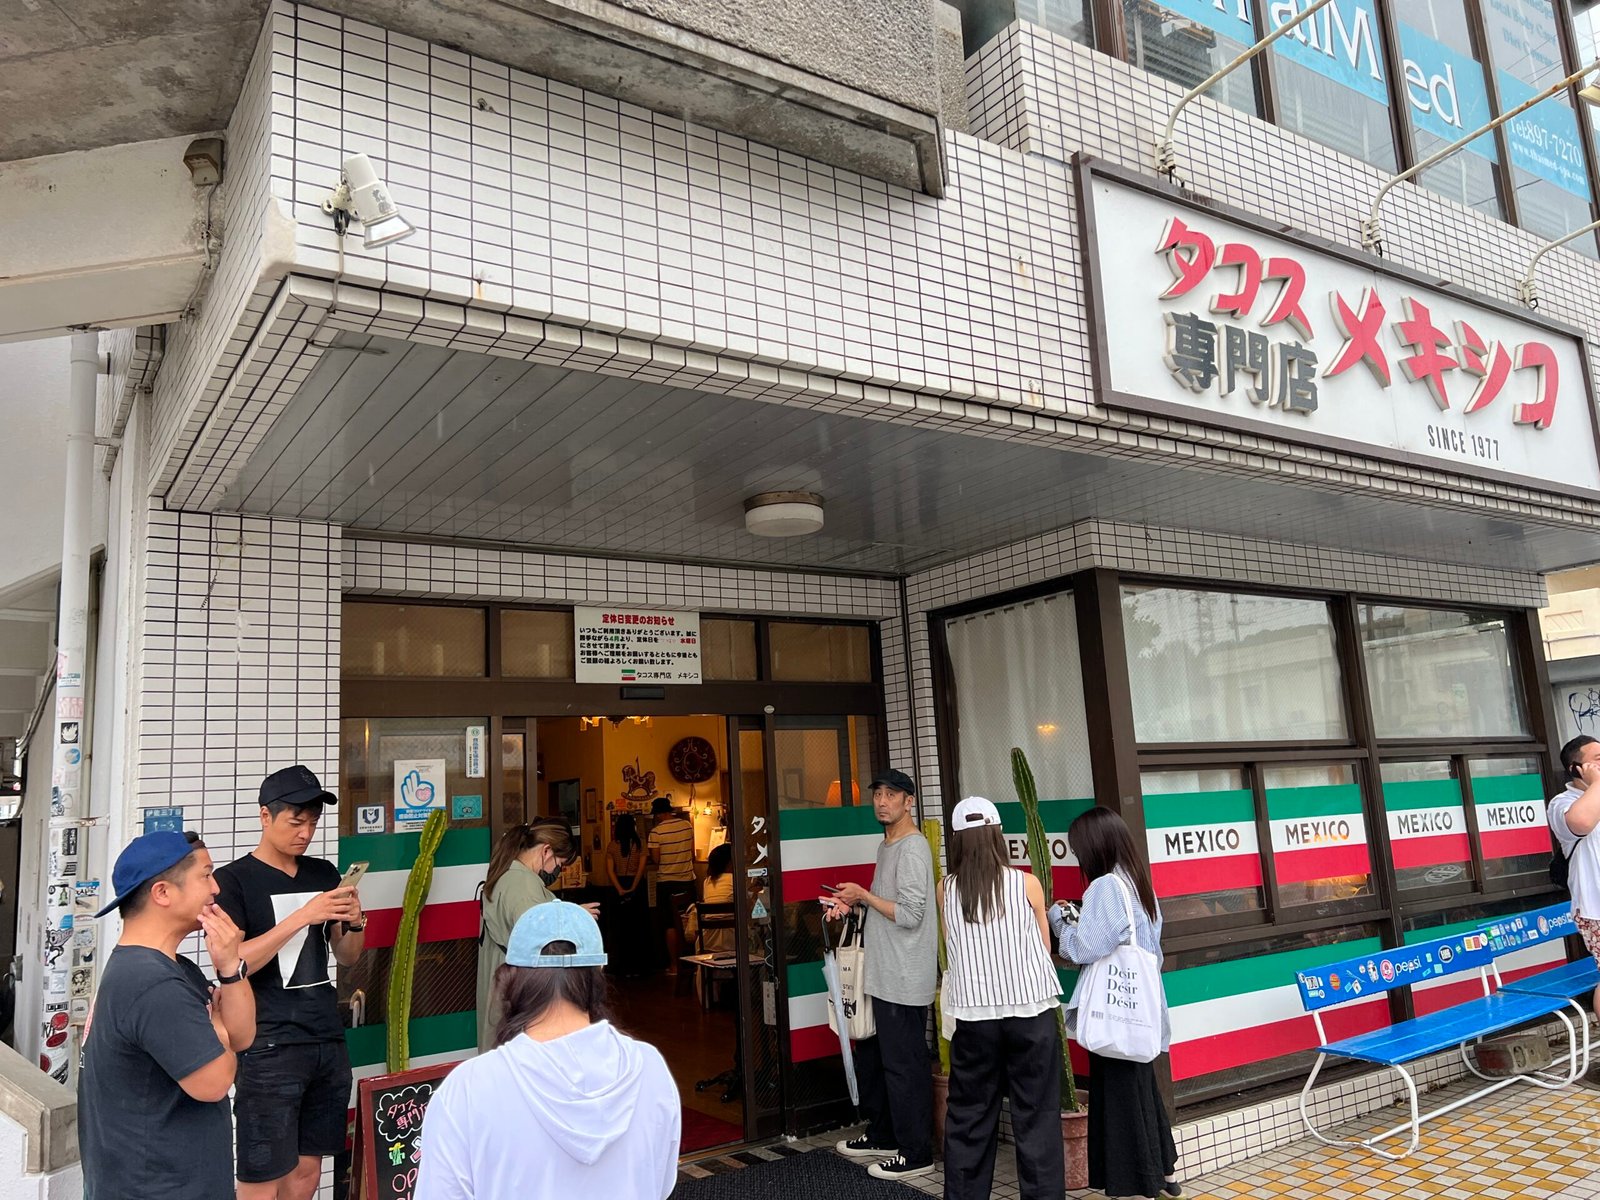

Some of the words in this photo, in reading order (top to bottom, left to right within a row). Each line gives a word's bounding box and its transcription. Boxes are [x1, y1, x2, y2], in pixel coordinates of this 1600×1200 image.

[1154, 216, 1315, 342] タコス
[1162, 311, 1320, 417] 専門店
[1322, 286, 1560, 430] メキシコ
[1427, 424, 1467, 454] SINCE
[1471, 433, 1500, 461] 1977
[602, 613, 675, 626] 定休日変更のお知らせ
[636, 671, 672, 680] タコス専門店
[677, 671, 699, 680] メキシコ
[1397, 811, 1453, 835] MEXICO
[1490, 805, 1536, 827] MEXICO
[1164, 828, 1240, 856] MEXICO
[1285, 820, 1350, 846] MEXICO
[1395, 955, 1422, 977] pepsi
[387, 1098, 417, 1119] タコス
